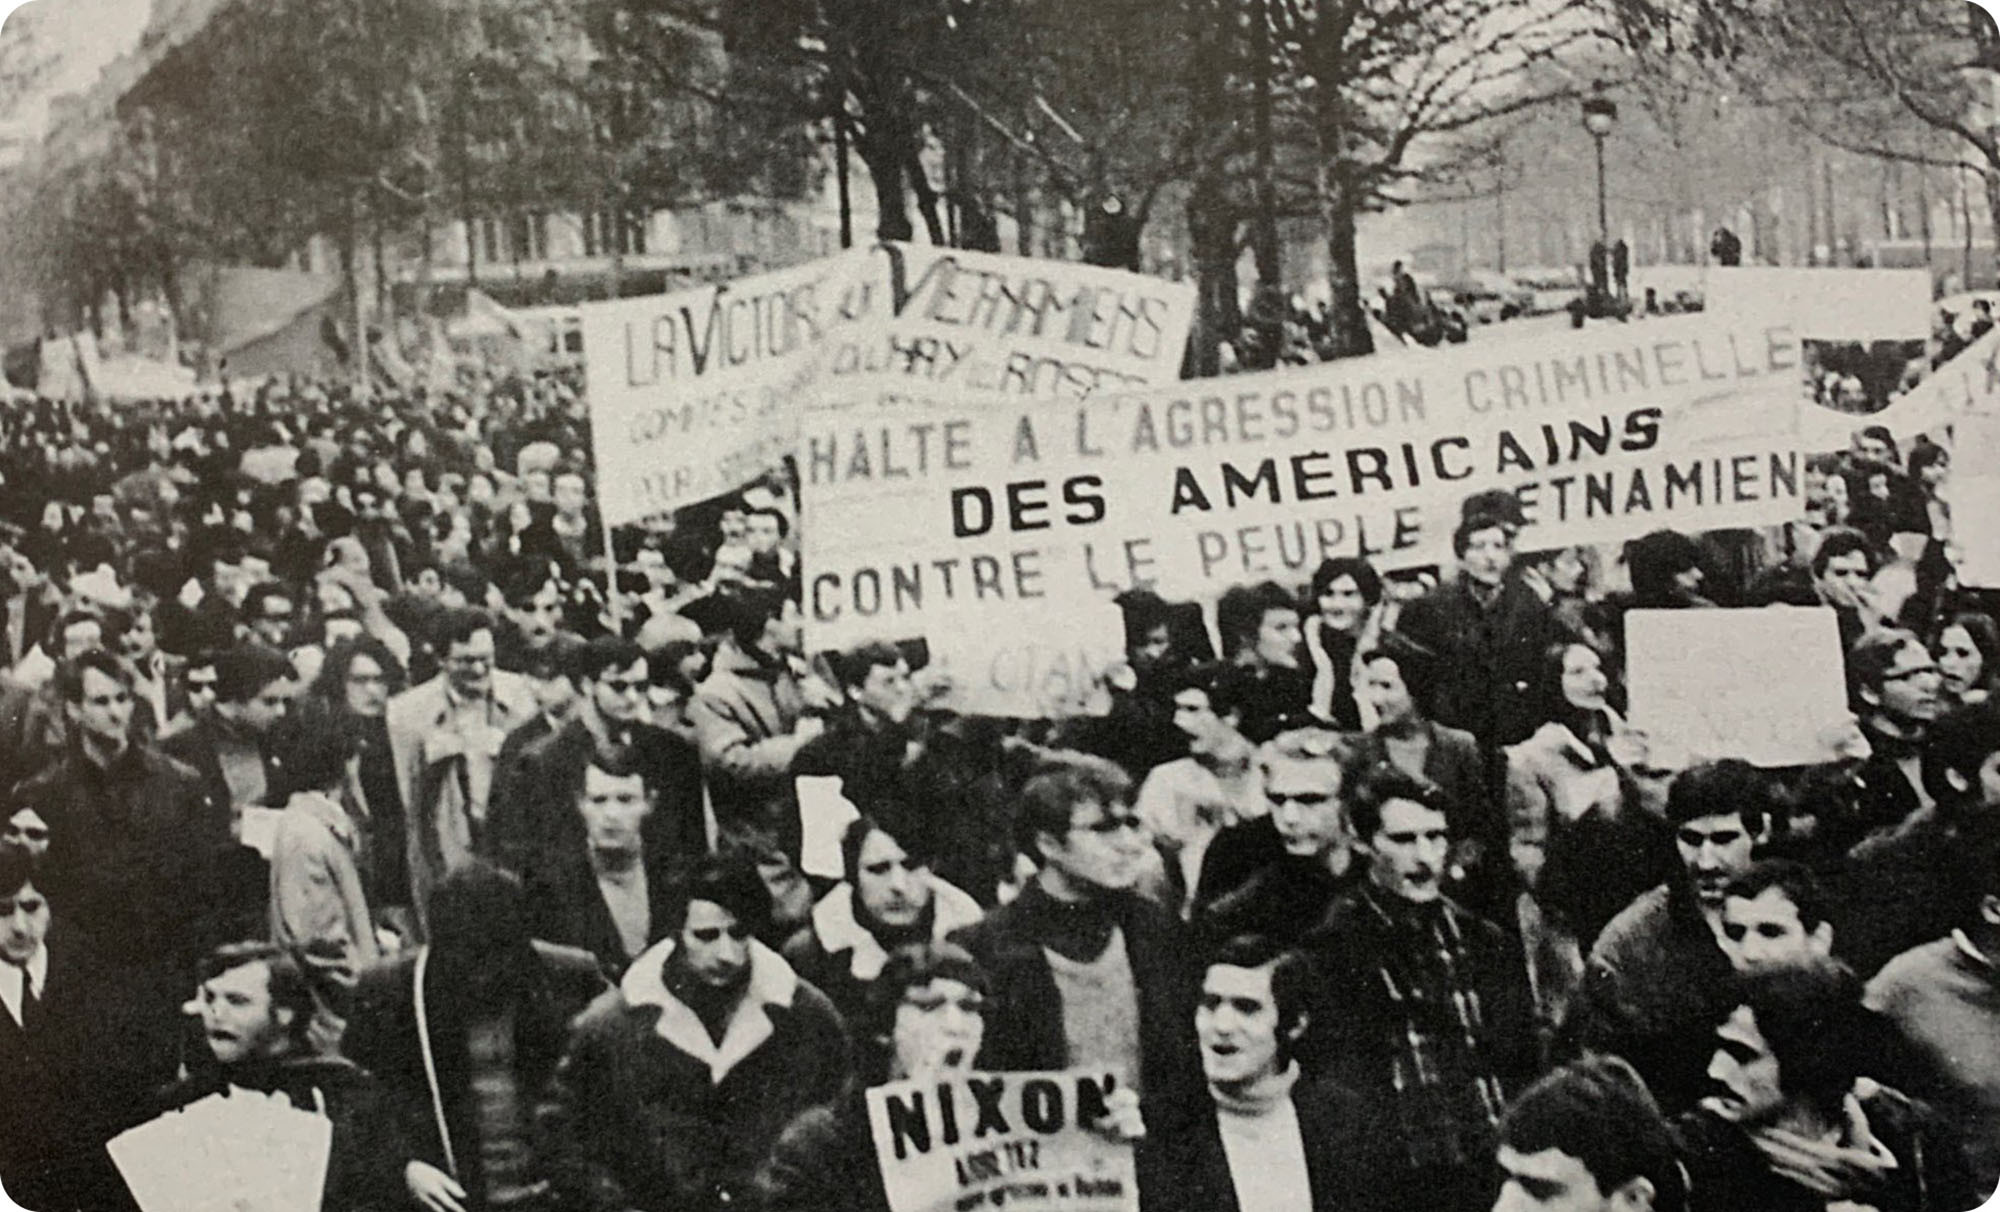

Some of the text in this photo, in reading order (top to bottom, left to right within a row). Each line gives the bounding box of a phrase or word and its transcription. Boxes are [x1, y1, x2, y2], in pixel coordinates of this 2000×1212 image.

[625, 312, 677, 387] LA
[809, 419, 972, 487] HALTE
[1013, 413, 1040, 465] A
[1077, 378, 1427, 458] L'AGRESSION
[1465, 325, 1797, 415] CRIMINELLE
[812, 451, 1799, 623] CONTRE LE PEUPLE ETNAMIEN
[951, 474, 1106, 538] DES
[886, 1073, 1116, 1160] NIXON
